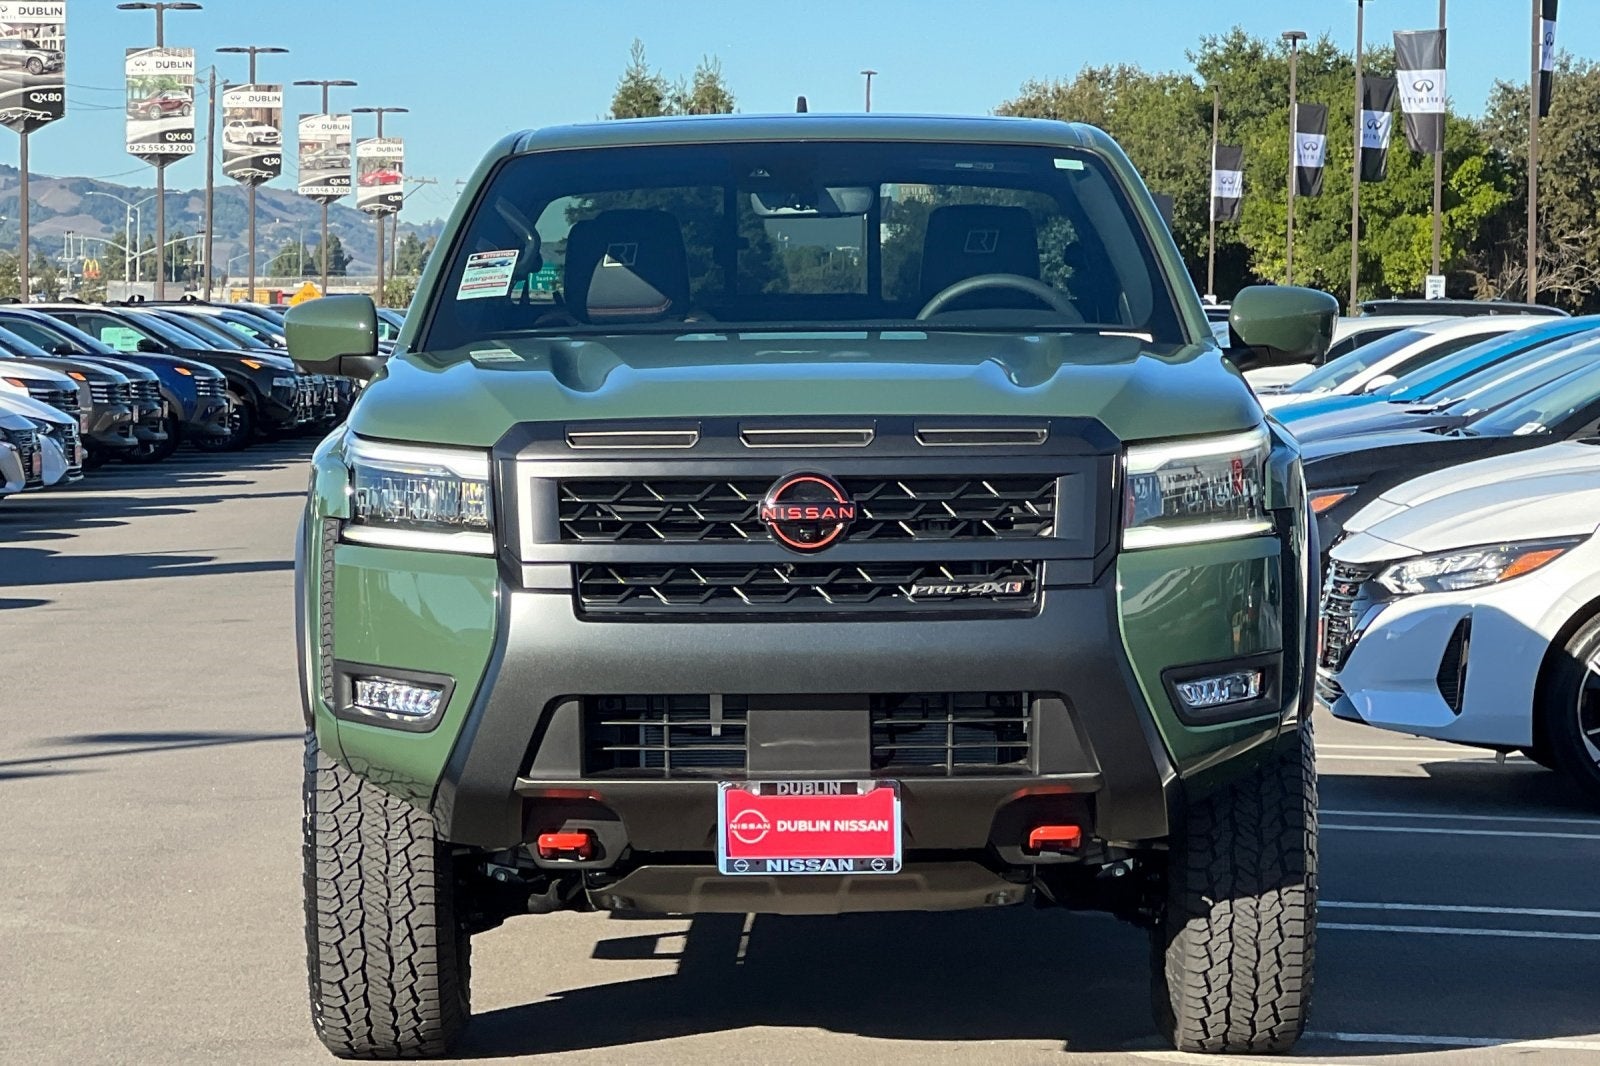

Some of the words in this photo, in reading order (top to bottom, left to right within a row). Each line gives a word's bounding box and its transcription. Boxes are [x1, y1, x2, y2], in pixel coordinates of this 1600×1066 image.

[18, 7, 63, 16] DUBLIN
[155, 61, 192, 69] DUBLIN
[30, 93, 62, 103] QX80
[165, 132, 193, 142] QX60
[129, 144, 147, 152] 925
[148, 144, 166, 152] 556
[168, 144, 194, 152] 3200
[262, 157, 281, 166] Q50
[761, 506, 855, 520] NISSAN
[776, 782, 841, 795] DUBLIN
[729, 823, 771, 831] NISSAN
[776, 820, 831, 832] DUBLIN
[833, 820, 889, 832] NISSAN
[766, 859, 854, 872] NISSAN
